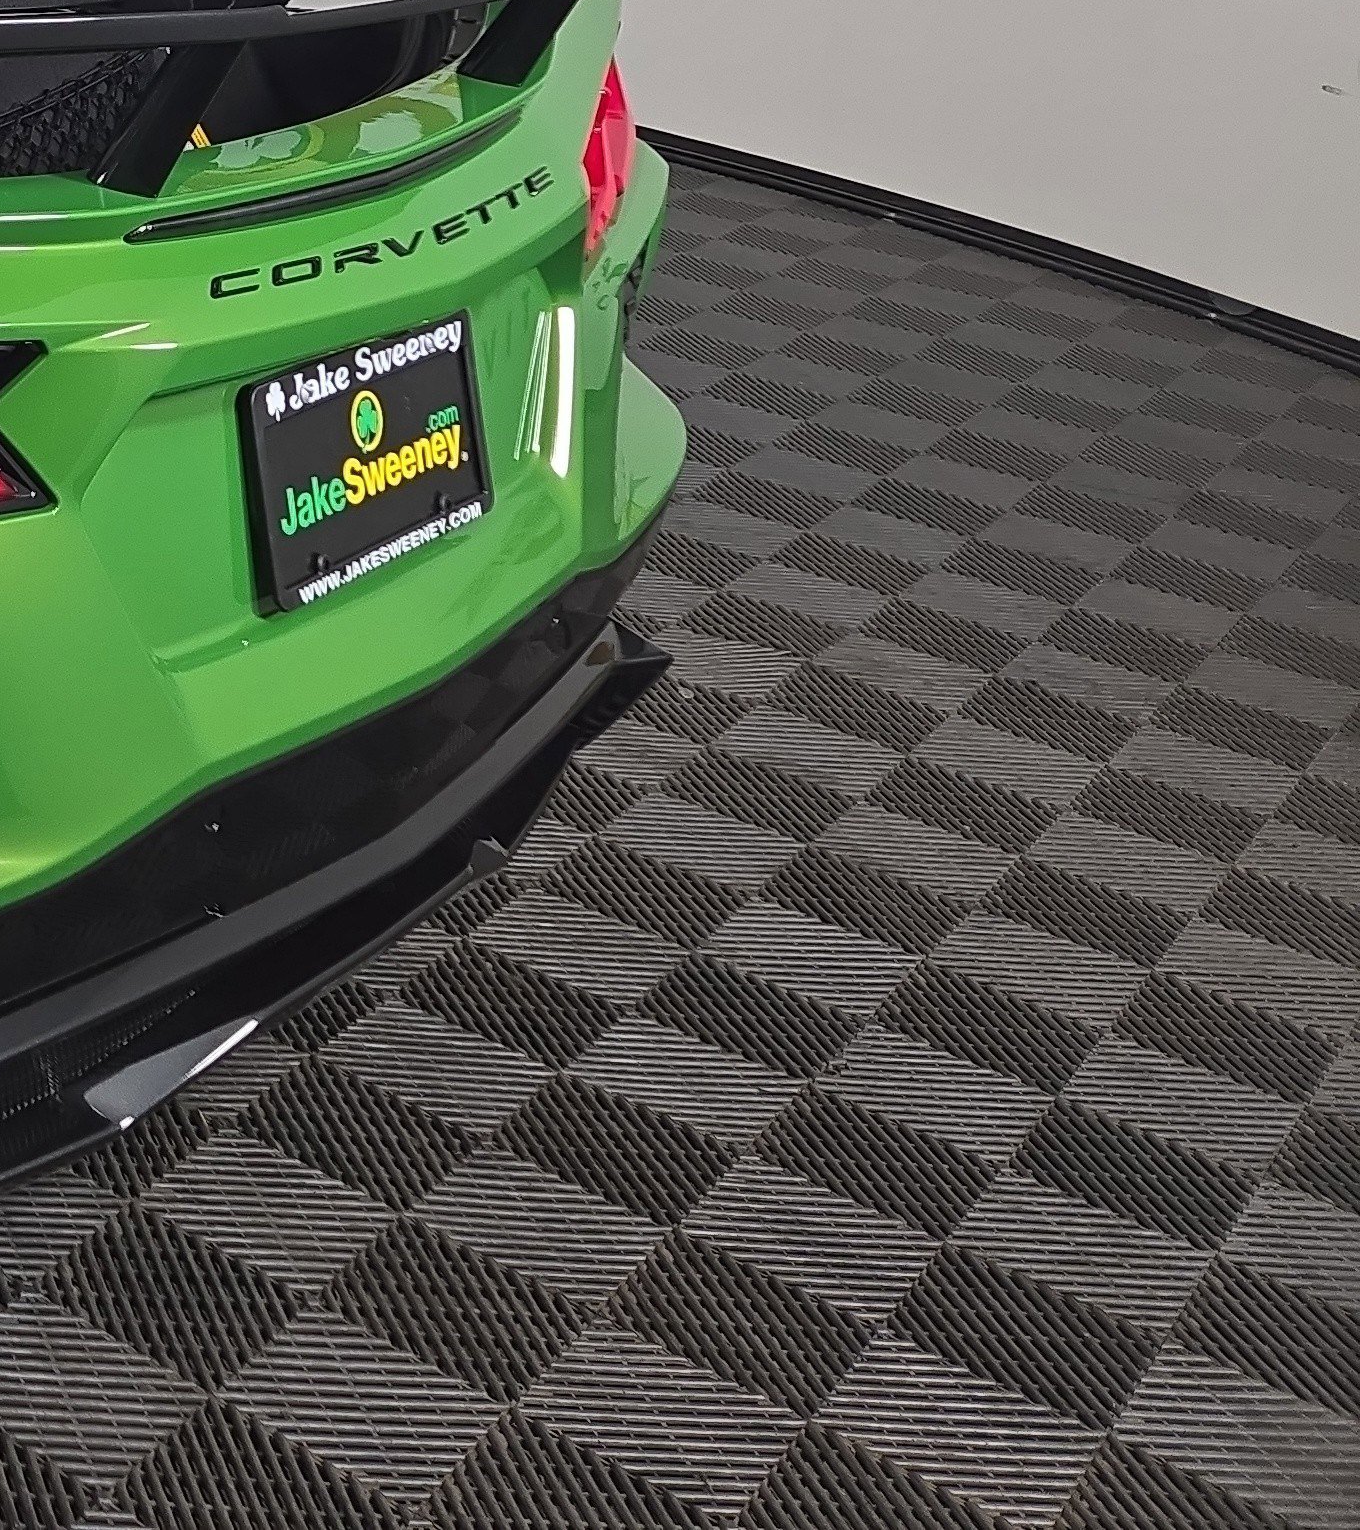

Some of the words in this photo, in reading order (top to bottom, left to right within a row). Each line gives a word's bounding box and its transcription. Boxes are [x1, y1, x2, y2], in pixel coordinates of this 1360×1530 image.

[209, 166, 555, 299] CORVETTE
[289, 362, 351, 409] Jake
[354, 320, 463, 382] Sweeney
[426, 403, 460, 432] .com
[298, 501, 483, 605] WWW.JAKESWEENEY.COM
